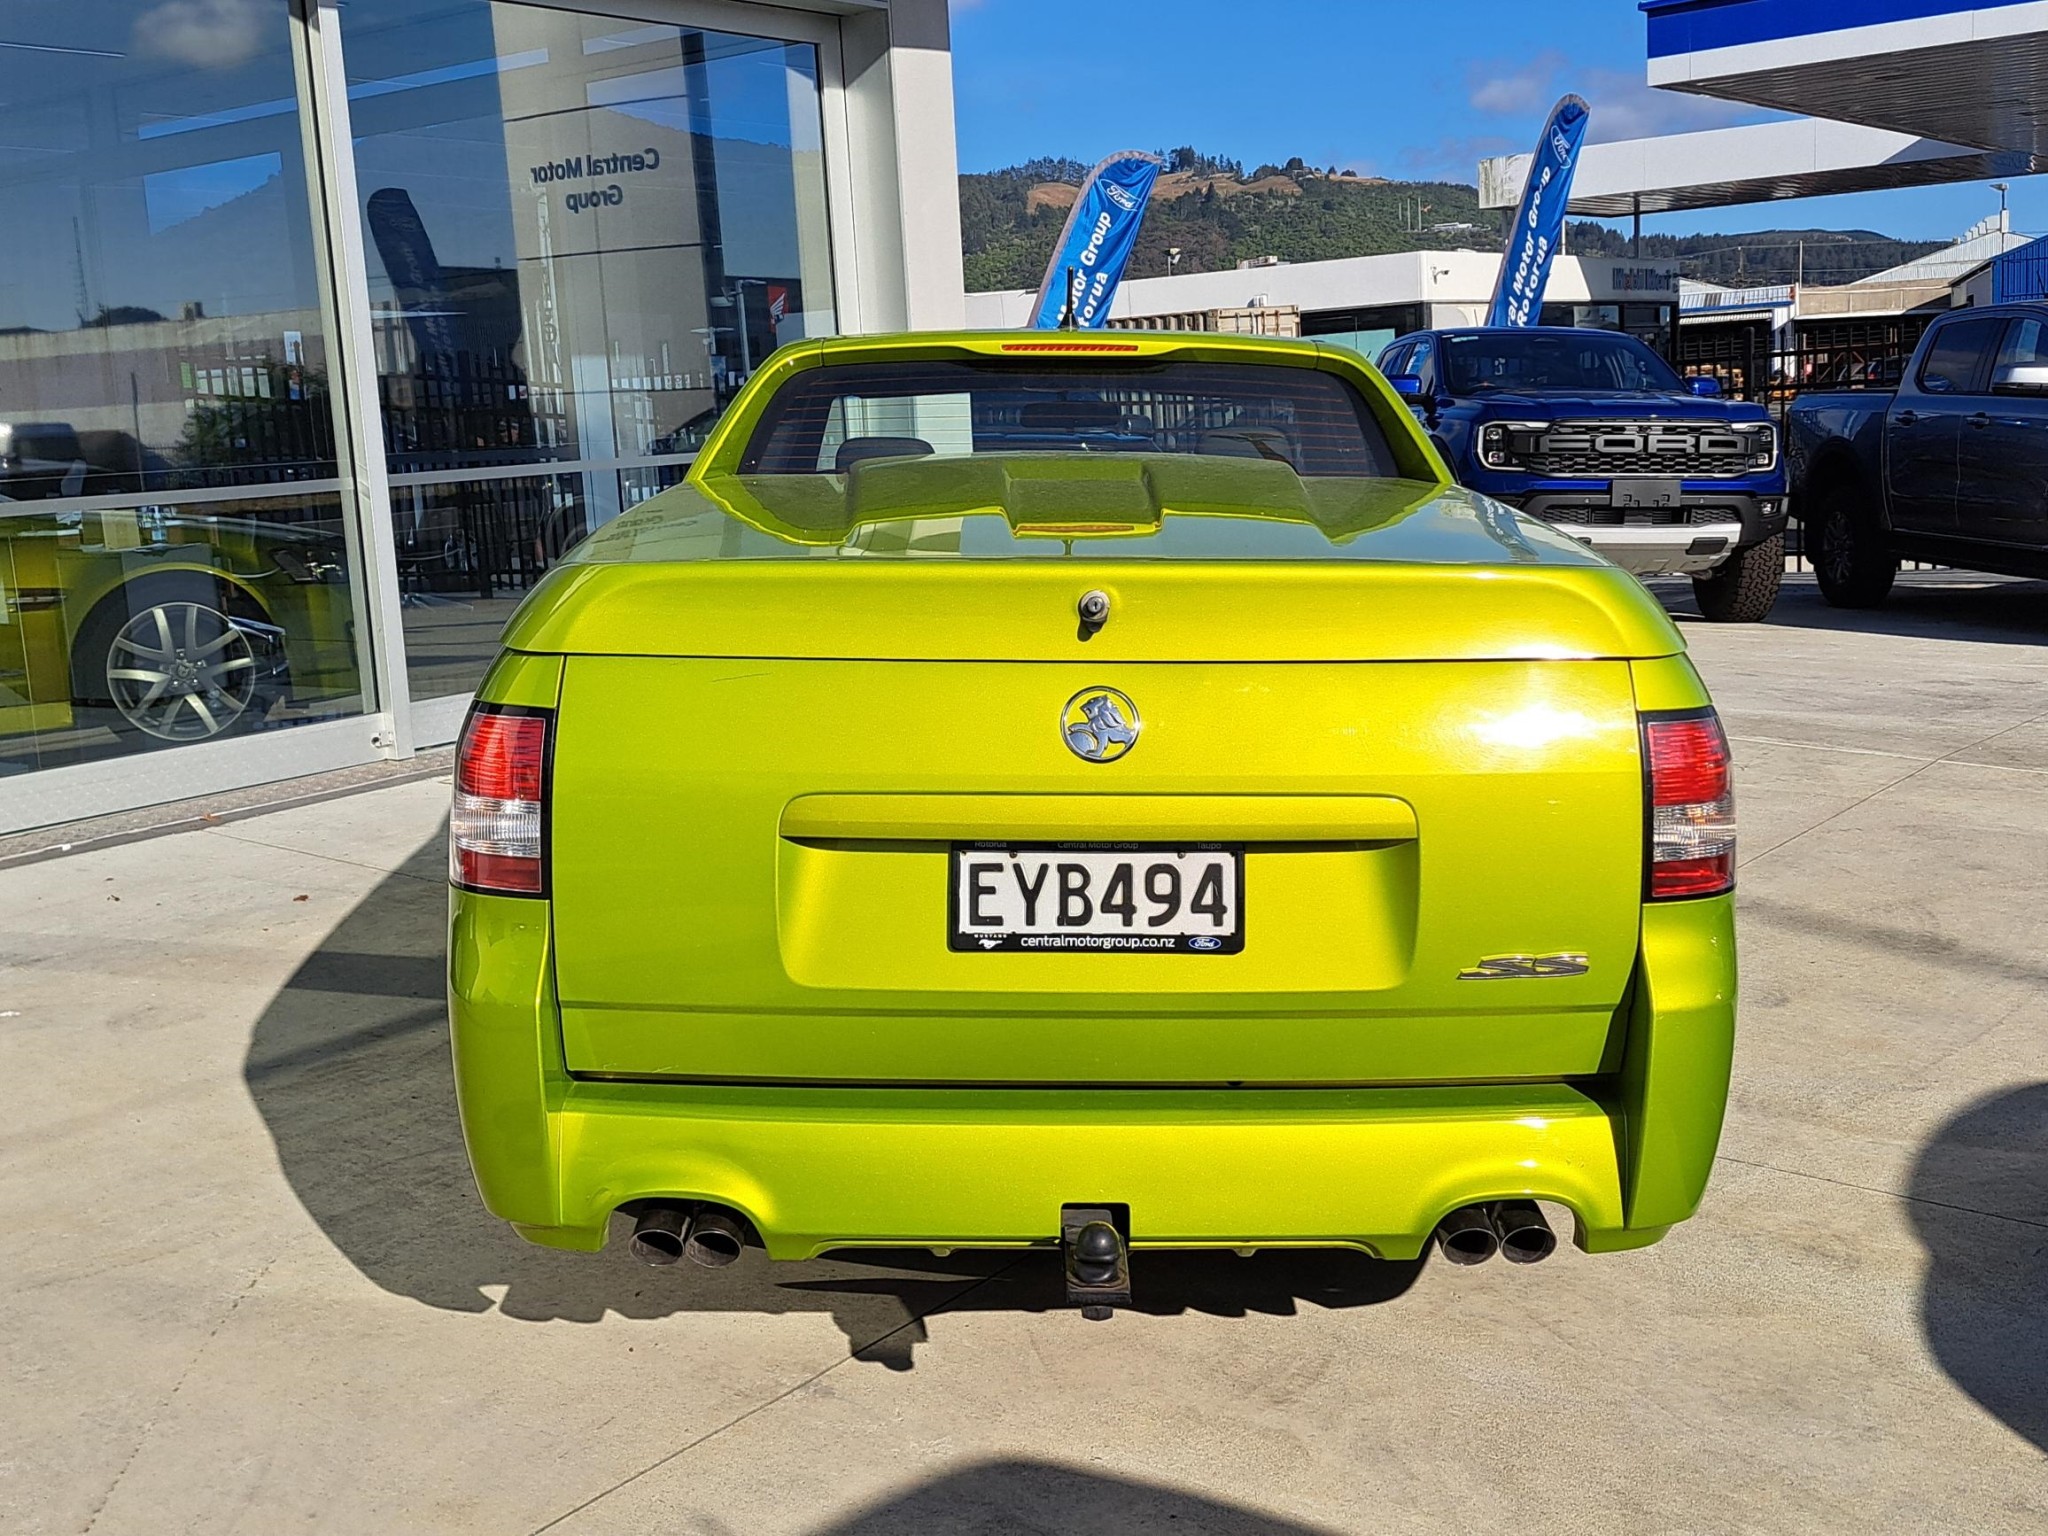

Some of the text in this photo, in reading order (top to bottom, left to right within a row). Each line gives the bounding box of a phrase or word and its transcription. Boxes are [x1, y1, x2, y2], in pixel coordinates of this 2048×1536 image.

[1106, 185, 1137, 209] Ford
[1080, 212, 1112, 267] Group
[1512, 230, 1535, 296] Motor
[1516, 236, 1549, 328] Rotorua
[1540, 433, 1748, 454] FORD
[969, 863, 1228, 927] EYB494
[1020, 935, 1176, 949] centralmotorgroup.co.nz
